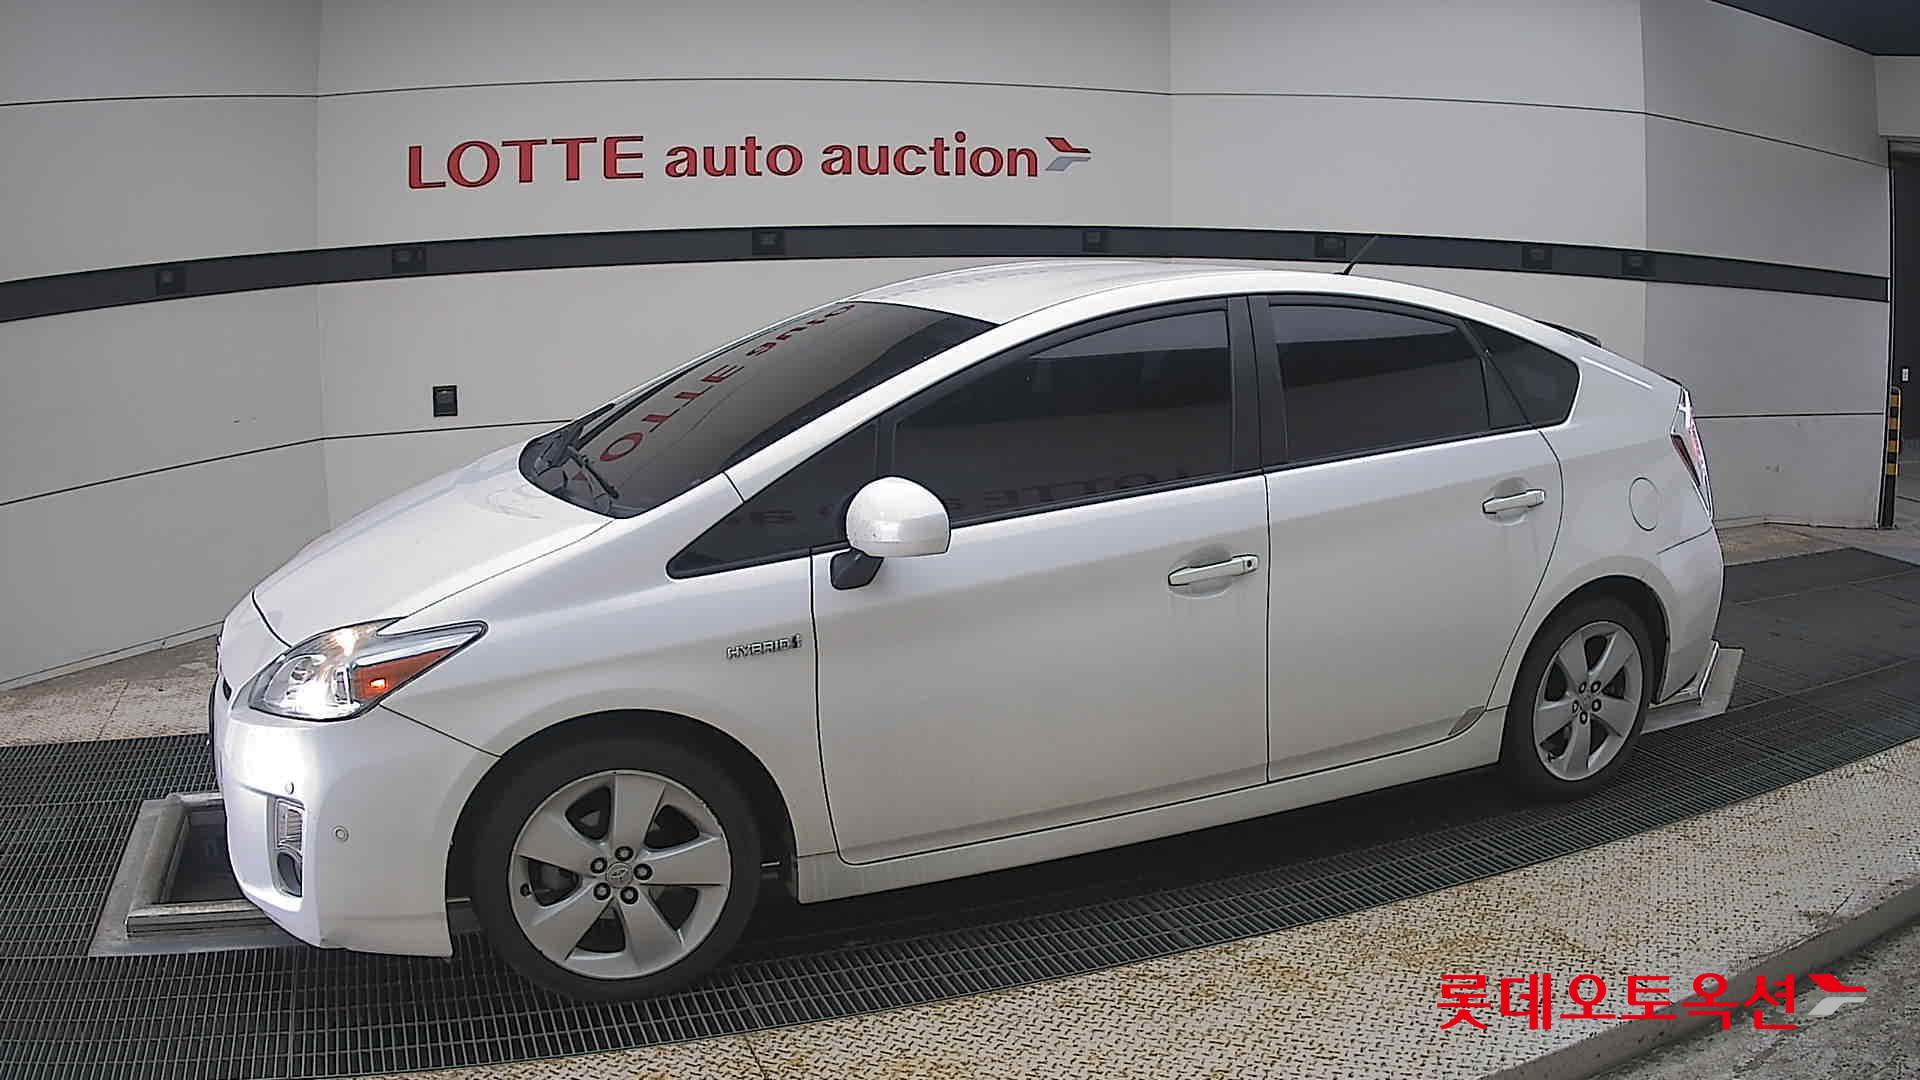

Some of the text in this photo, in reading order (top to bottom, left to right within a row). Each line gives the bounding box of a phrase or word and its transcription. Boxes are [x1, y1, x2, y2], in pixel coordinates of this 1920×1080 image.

[408, 131, 1040, 191] LOTTE auto auction
[726, 638, 790, 659] HYBRID
